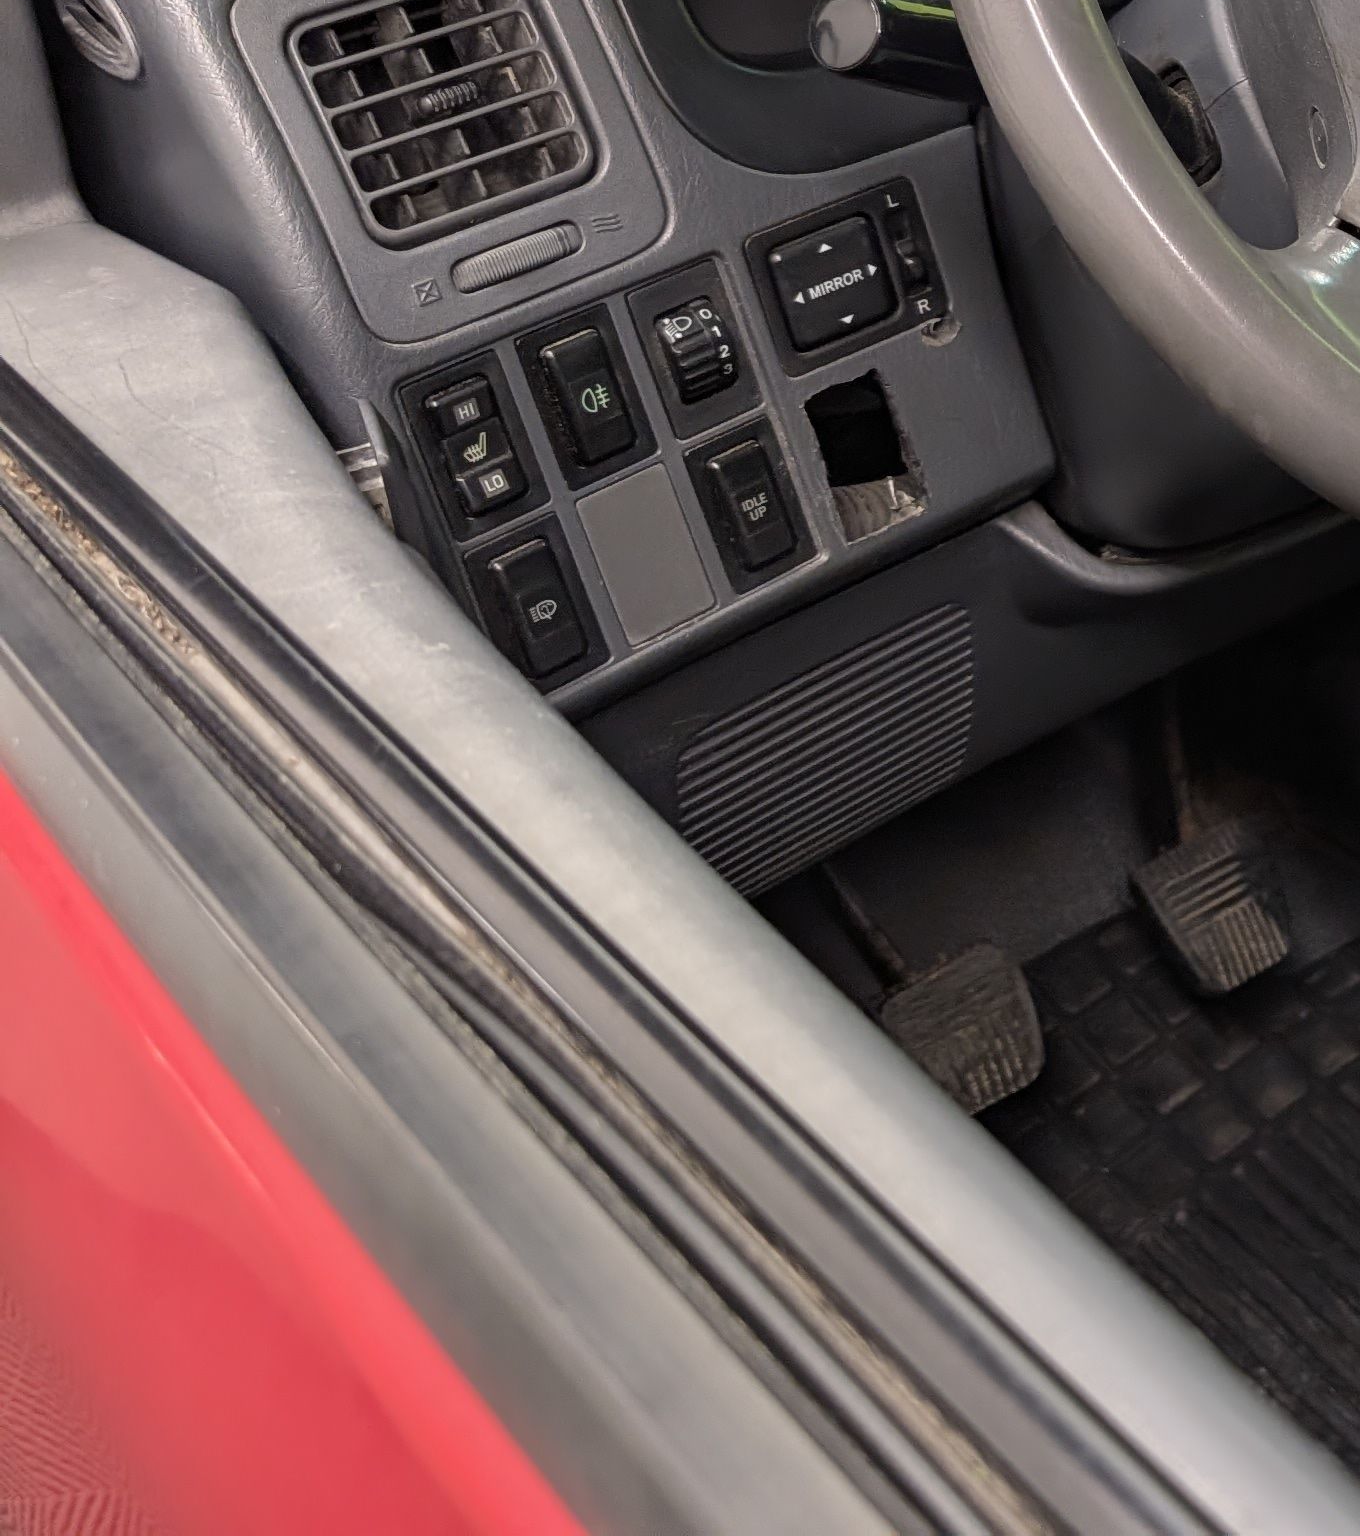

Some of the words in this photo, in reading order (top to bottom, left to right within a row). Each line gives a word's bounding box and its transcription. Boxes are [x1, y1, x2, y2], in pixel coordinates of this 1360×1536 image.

[885, 194, 900, 208] L
[808, 268, 865, 300] MIRROR
[917, 298, 931, 314] R
[699, 308, 713, 320] 0
[711, 325, 722, 337] 1
[719, 344, 731, 359] 2
[723, 363, 733, 375] 3
[458, 402, 476, 420] HI
[484, 474, 504, 492] LO
[741, 492, 768, 512] IDLE
[749, 506, 767, 521] UP
